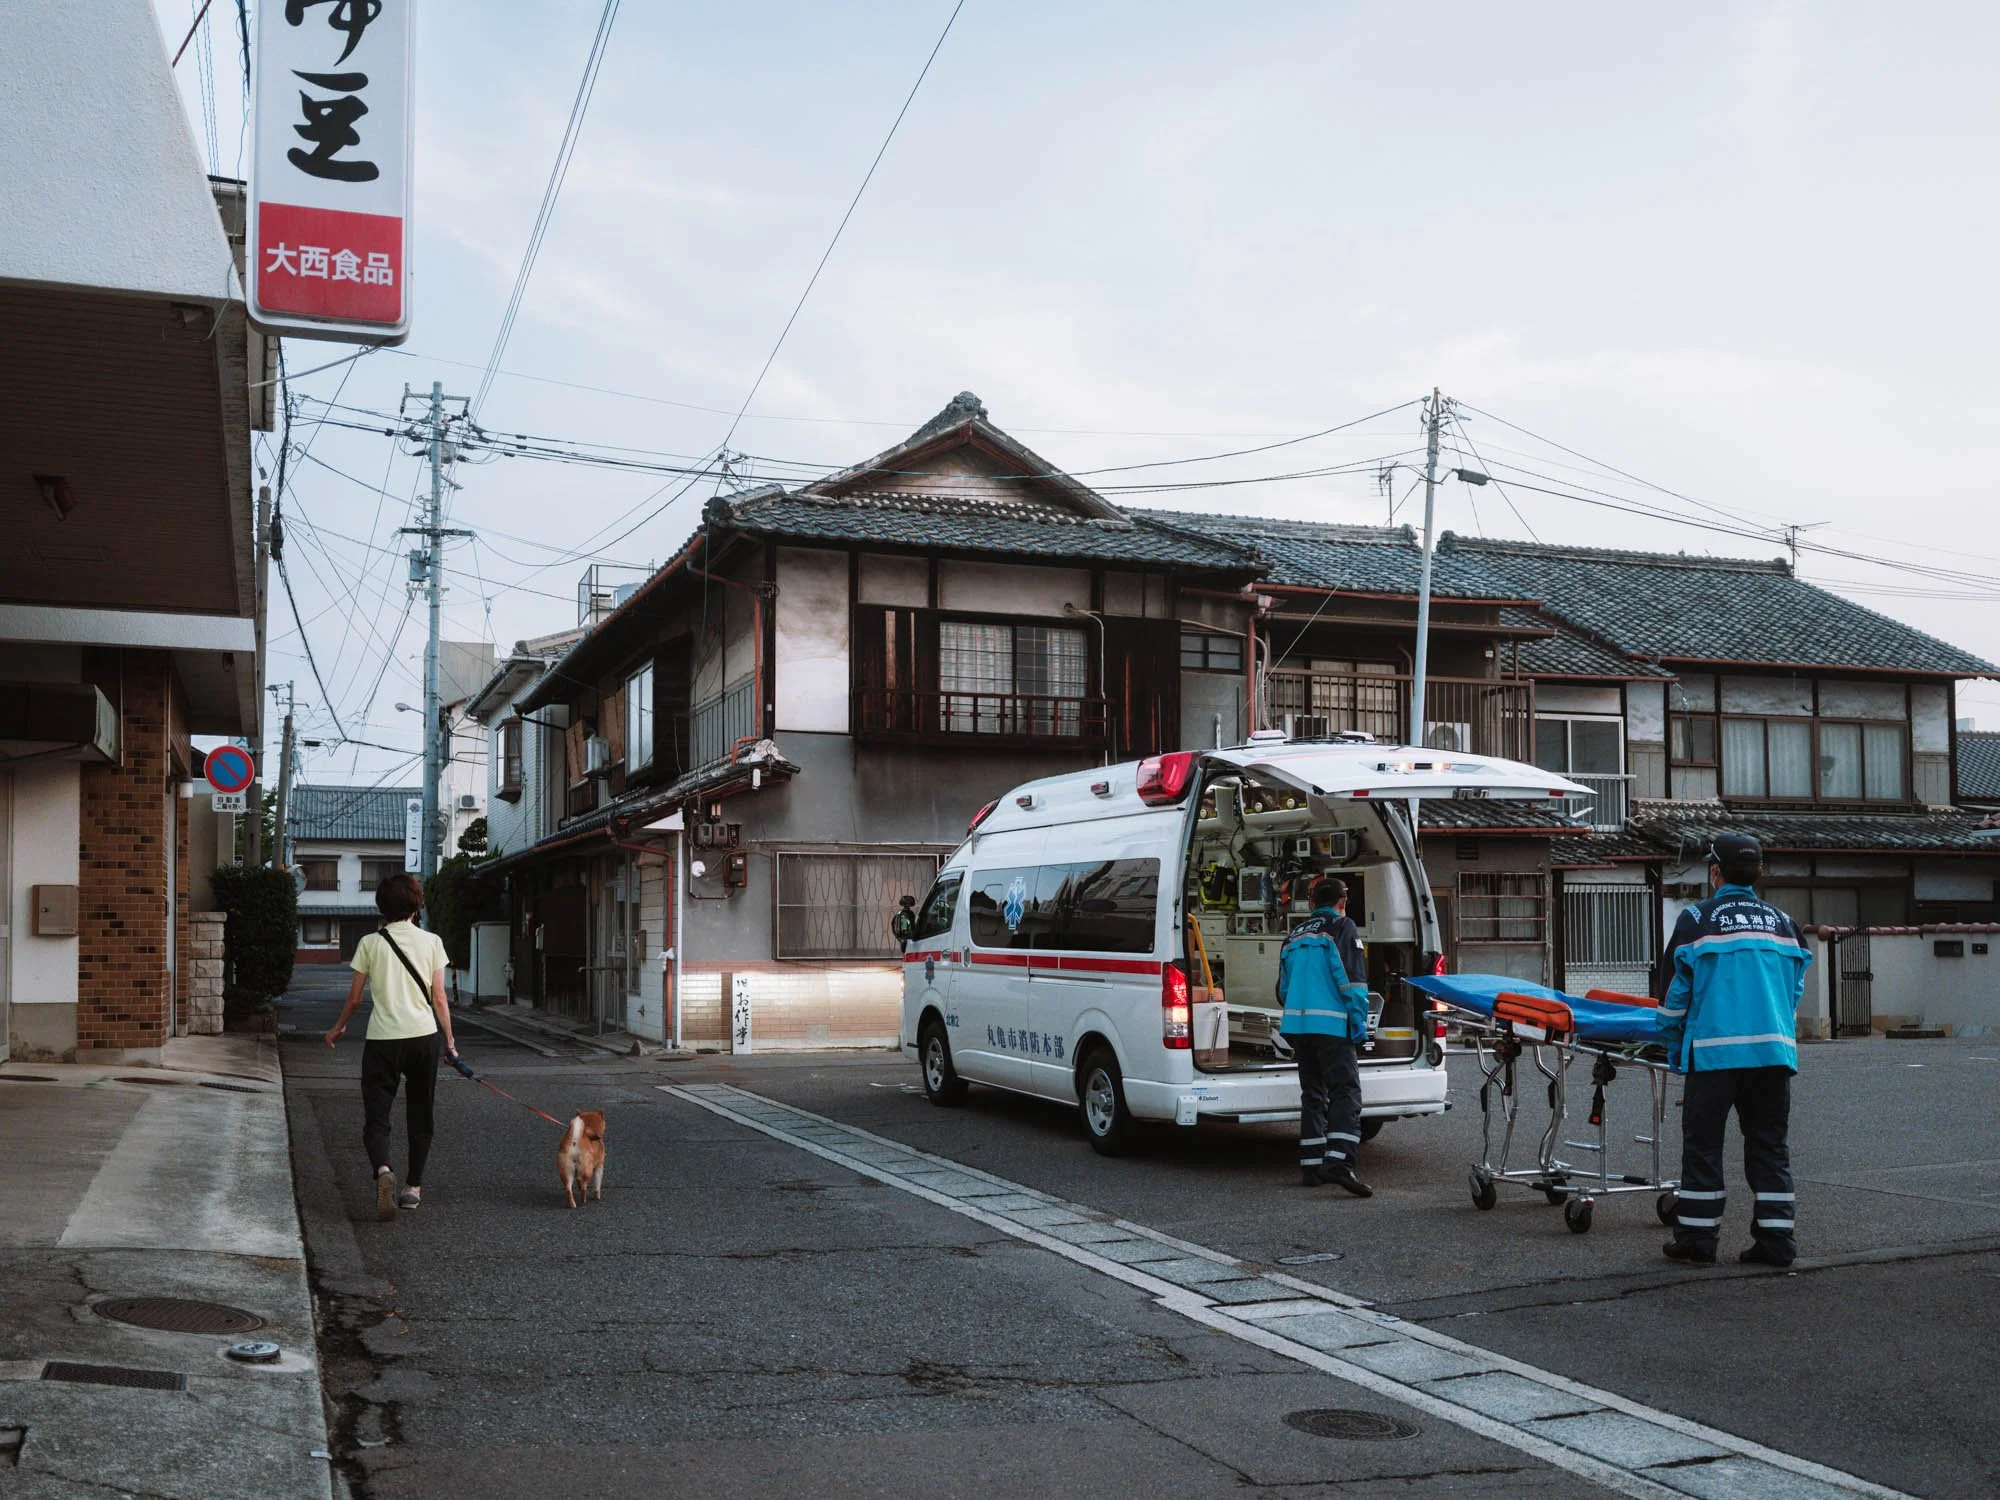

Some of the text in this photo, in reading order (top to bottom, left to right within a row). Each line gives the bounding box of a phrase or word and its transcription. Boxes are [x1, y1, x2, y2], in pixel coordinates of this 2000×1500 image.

[266, 242, 393, 286] 大西食品
[1719, 914, 1776, 926] 丸亀消防
[987, 1024, 1064, 1058] 丸亀市消防本部
